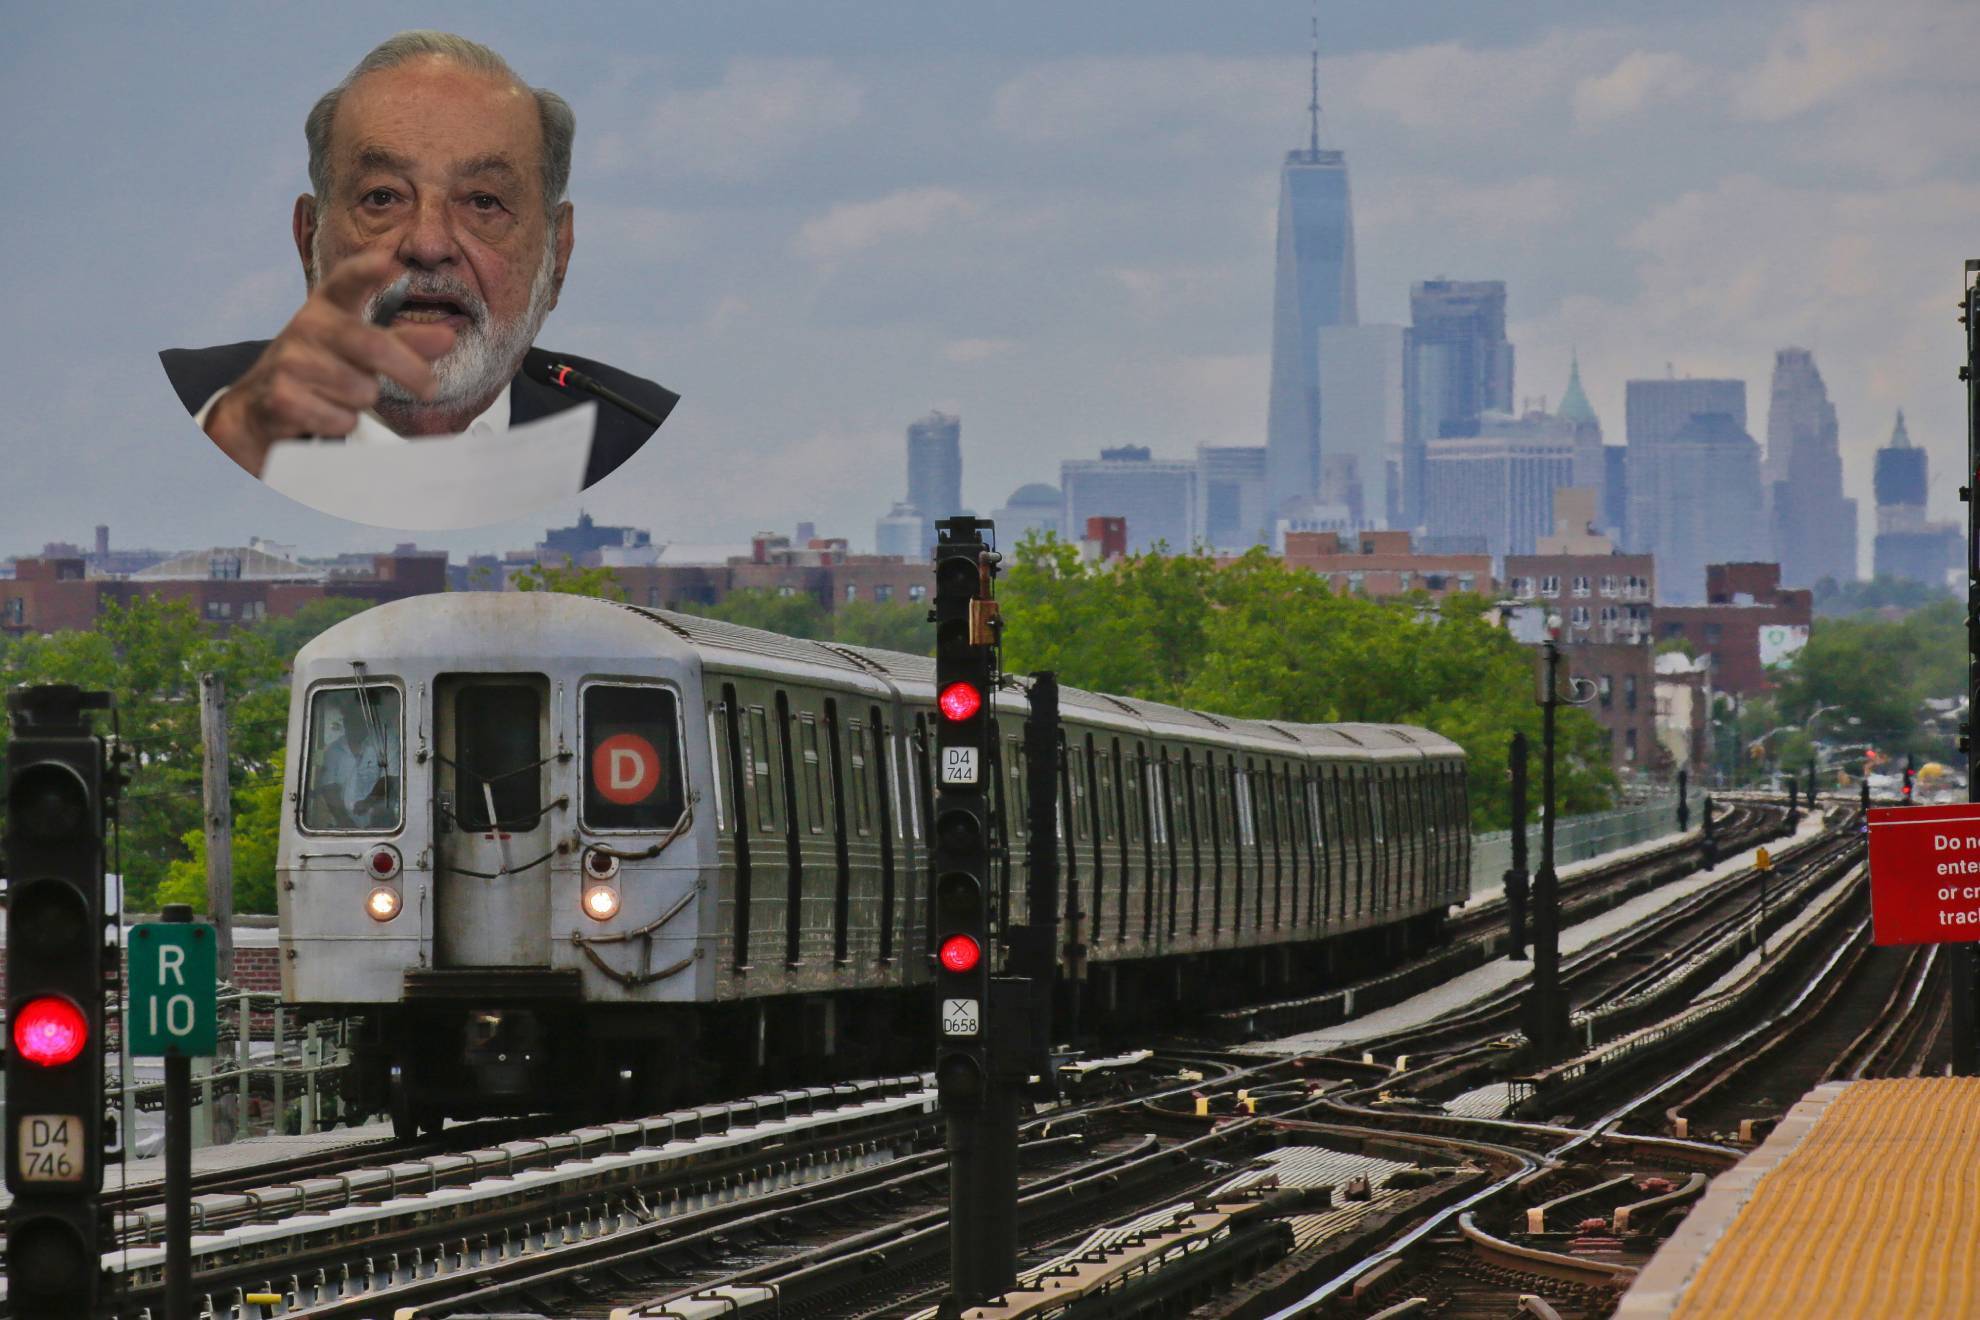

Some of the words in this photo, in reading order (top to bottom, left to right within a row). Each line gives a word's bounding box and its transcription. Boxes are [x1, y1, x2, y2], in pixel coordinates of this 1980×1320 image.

[949, 749, 970, 765] D4
[610, 748, 645, 790] D
[947, 767, 972, 781] 744
[1934, 834, 1961, 850] Do
[1966, 836, 1980, 849] n
[1937, 859, 1980, 876] ente
[1938, 886, 1958, 900] or
[1939, 907, 1980, 926] trac
[158, 944, 185, 986] R
[149, 994, 195, 1036] 10
[952, 1000, 969, 1016] X
[944, 1018, 977, 1033] D658
[32, 1119, 69, 1148] D4
[25, 1151, 72, 1177] 746
